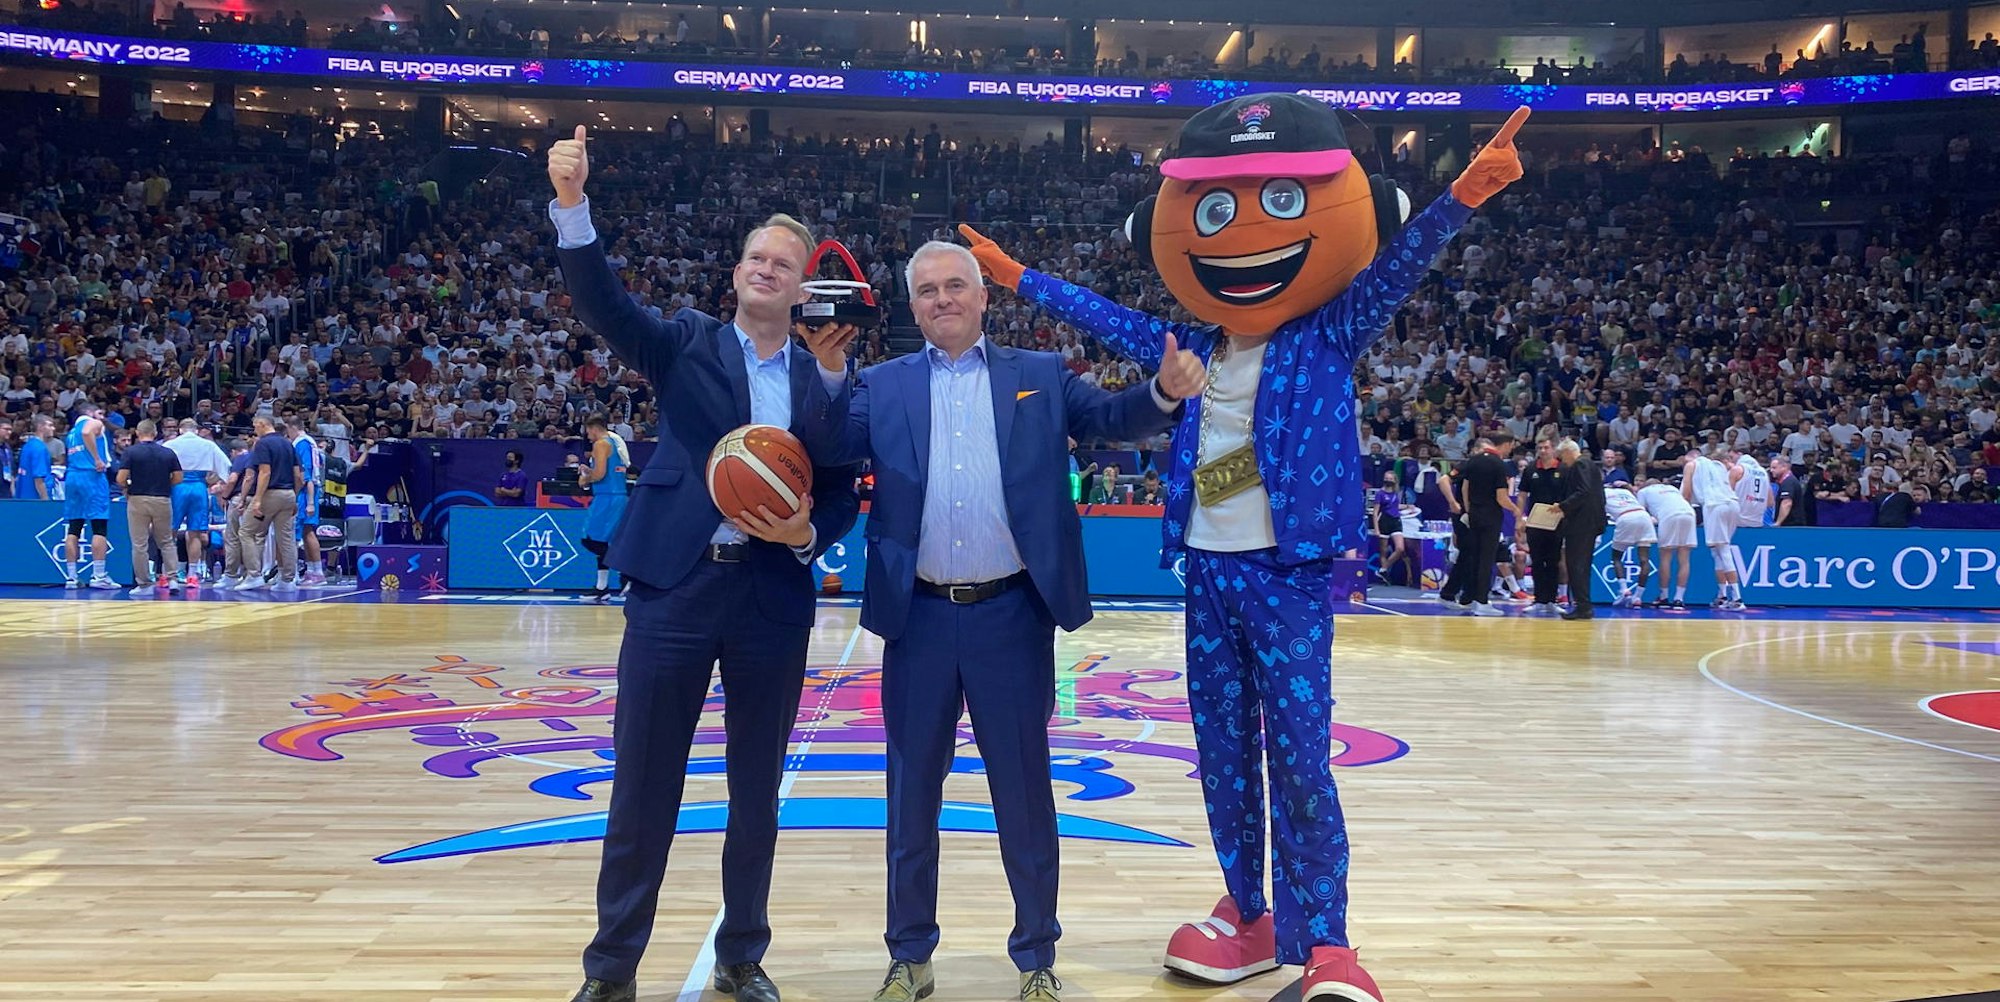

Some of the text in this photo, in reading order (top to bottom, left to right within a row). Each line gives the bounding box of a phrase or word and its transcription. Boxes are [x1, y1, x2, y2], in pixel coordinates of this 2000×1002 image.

[128, 44, 190, 62] 2022
[328, 57, 515, 78] FIBA EUROBASKET
[674, 70, 844, 89] GERMANY 2022
[1949, 75, 2000, 92] GER
[968, 81, 1144, 98] FIBA EUROBASKET
[1406, 92, 1462, 105] 2022
[1586, 88, 1774, 106] FIBA EUROBASKET
[777, 453, 809, 488] molten
[1753, 478, 1761, 493] 9
[528, 529, 553, 548] M
[518, 549, 562, 568] O'P
[1731, 545, 2000, 590] Marc O'P
